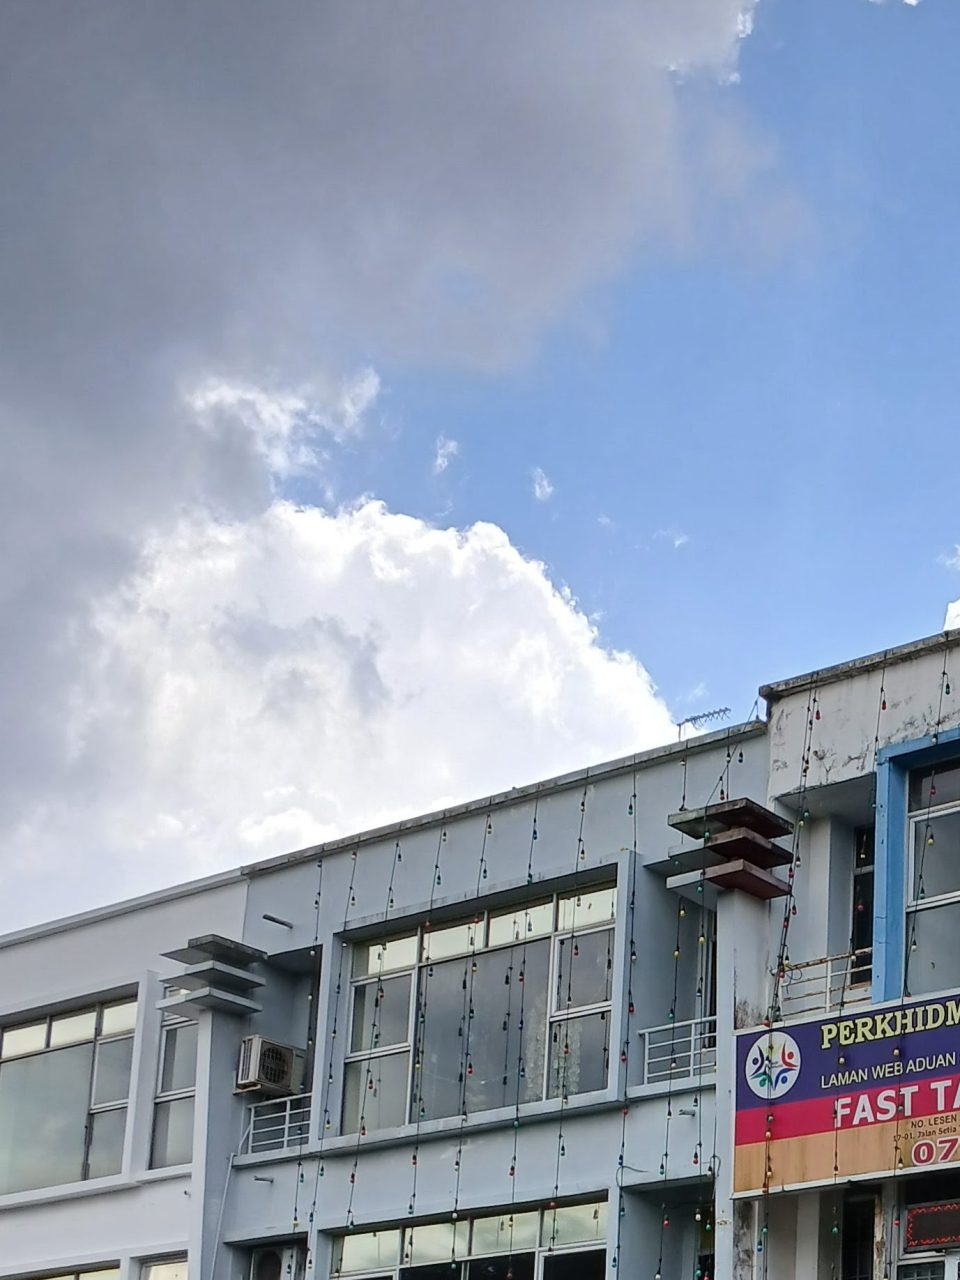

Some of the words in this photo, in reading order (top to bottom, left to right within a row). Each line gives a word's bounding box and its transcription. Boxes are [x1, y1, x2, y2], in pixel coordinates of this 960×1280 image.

[821, 1071, 868, 1089] LAMAN
[871, 1062, 903, 1080] WEB
[906, 1052, 956, 1073] ADUAN
[835, 1085, 918, 1128] FAST
[911, 1119, 926, 1129] NO.
[928, 1114, 957, 1126] LESEN
[918, 1130, 936, 1138] Jalan
[938, 1125, 957, 1134] Setia
